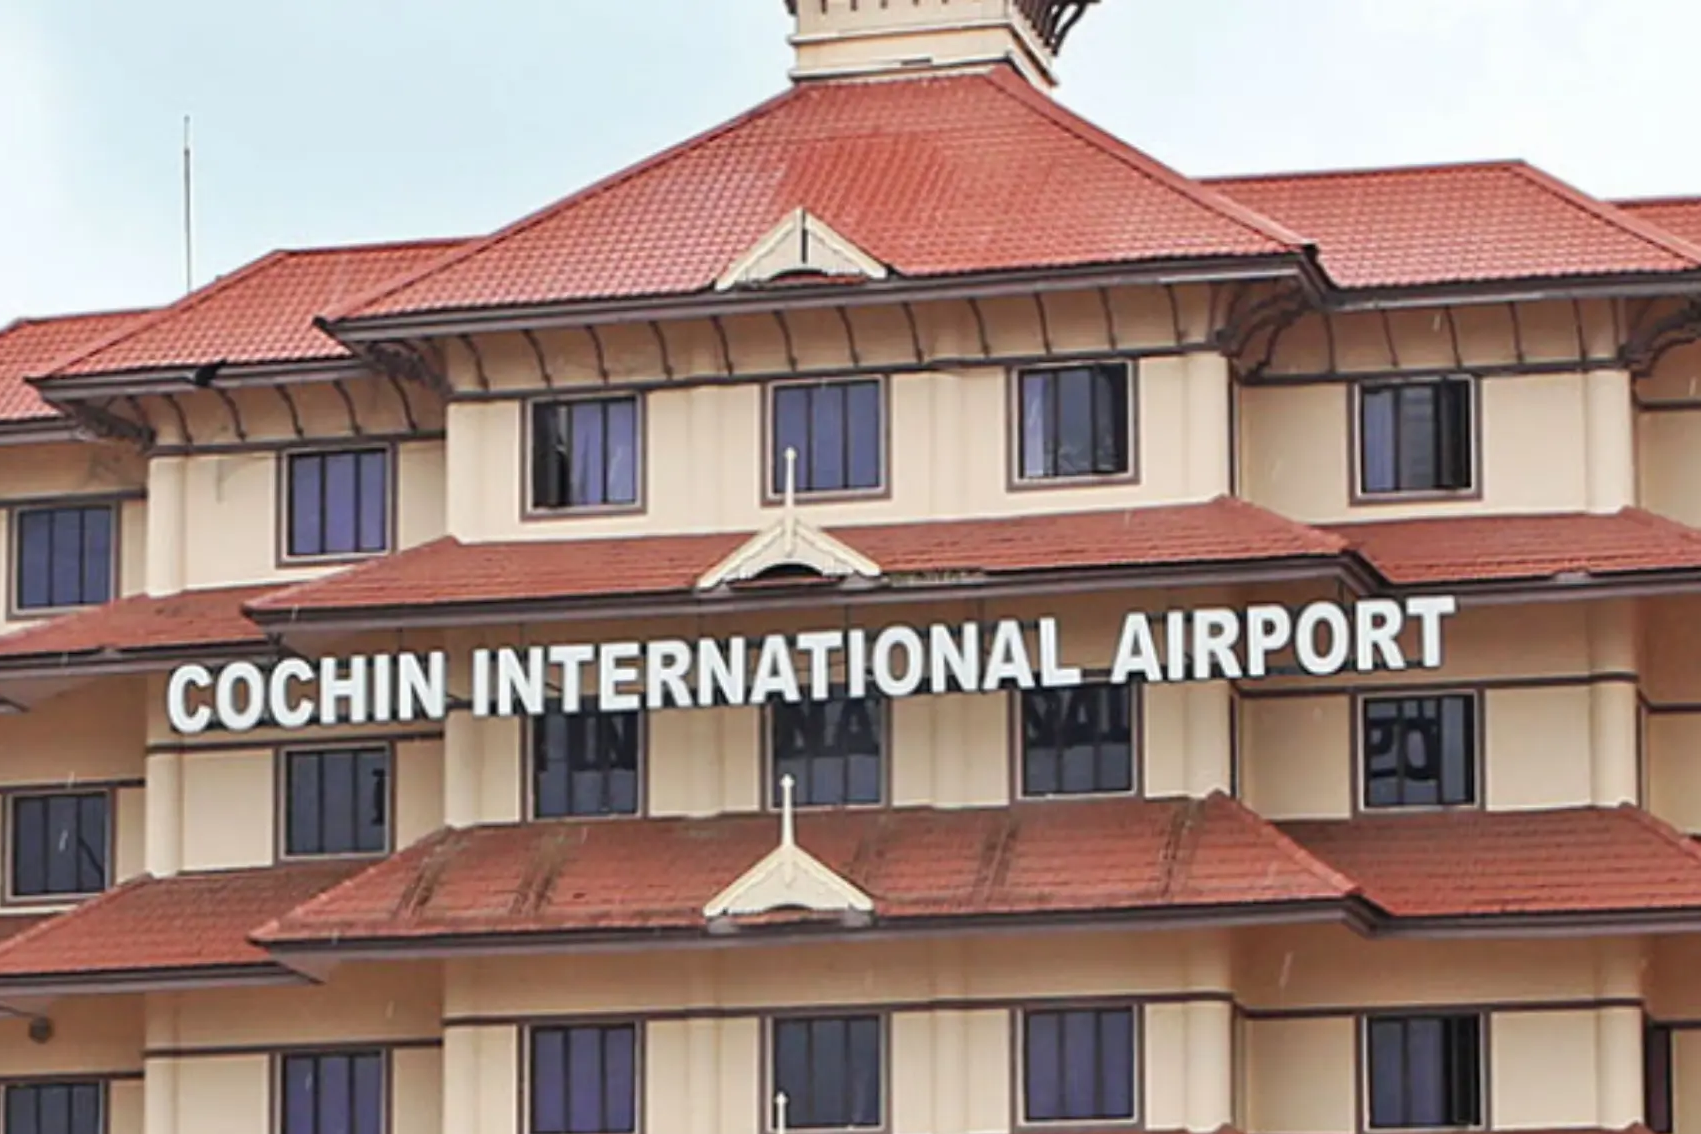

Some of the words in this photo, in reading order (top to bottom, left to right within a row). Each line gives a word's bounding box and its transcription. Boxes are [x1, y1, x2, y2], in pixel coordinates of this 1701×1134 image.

[167, 651, 446, 733] COCHIN
[472, 617, 1082, 716] INTERNATIONAL
[1110, 595, 1456, 683] AIRPORT
